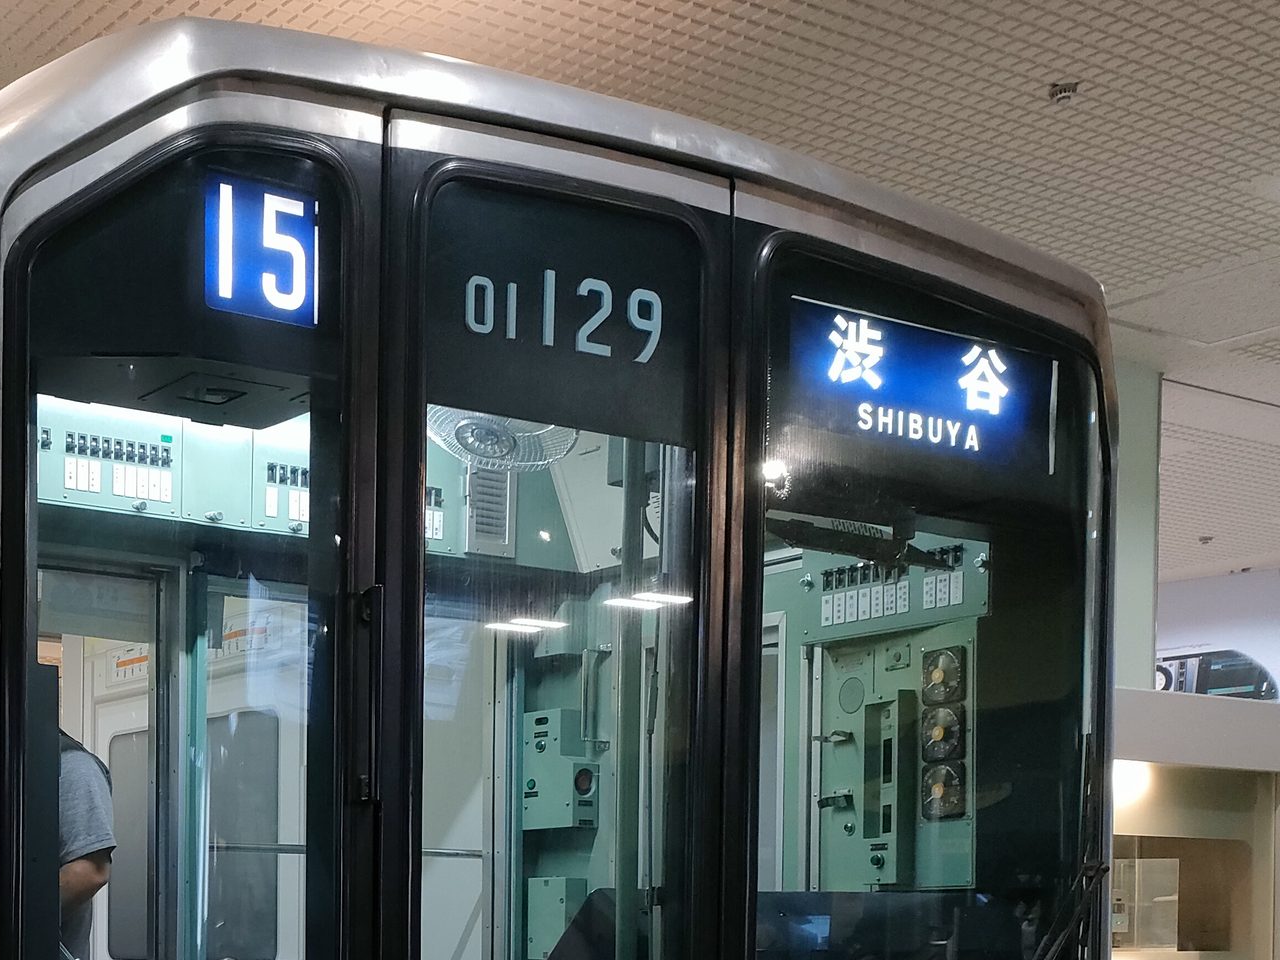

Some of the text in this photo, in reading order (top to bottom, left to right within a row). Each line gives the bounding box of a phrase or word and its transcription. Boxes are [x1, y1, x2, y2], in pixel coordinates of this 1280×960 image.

[218, 182, 308, 311] 15
[464, 268, 664, 364] 01129
[827, 314, 1010, 416] 渋谷
[856, 402, 980, 452] SHIBUYA
